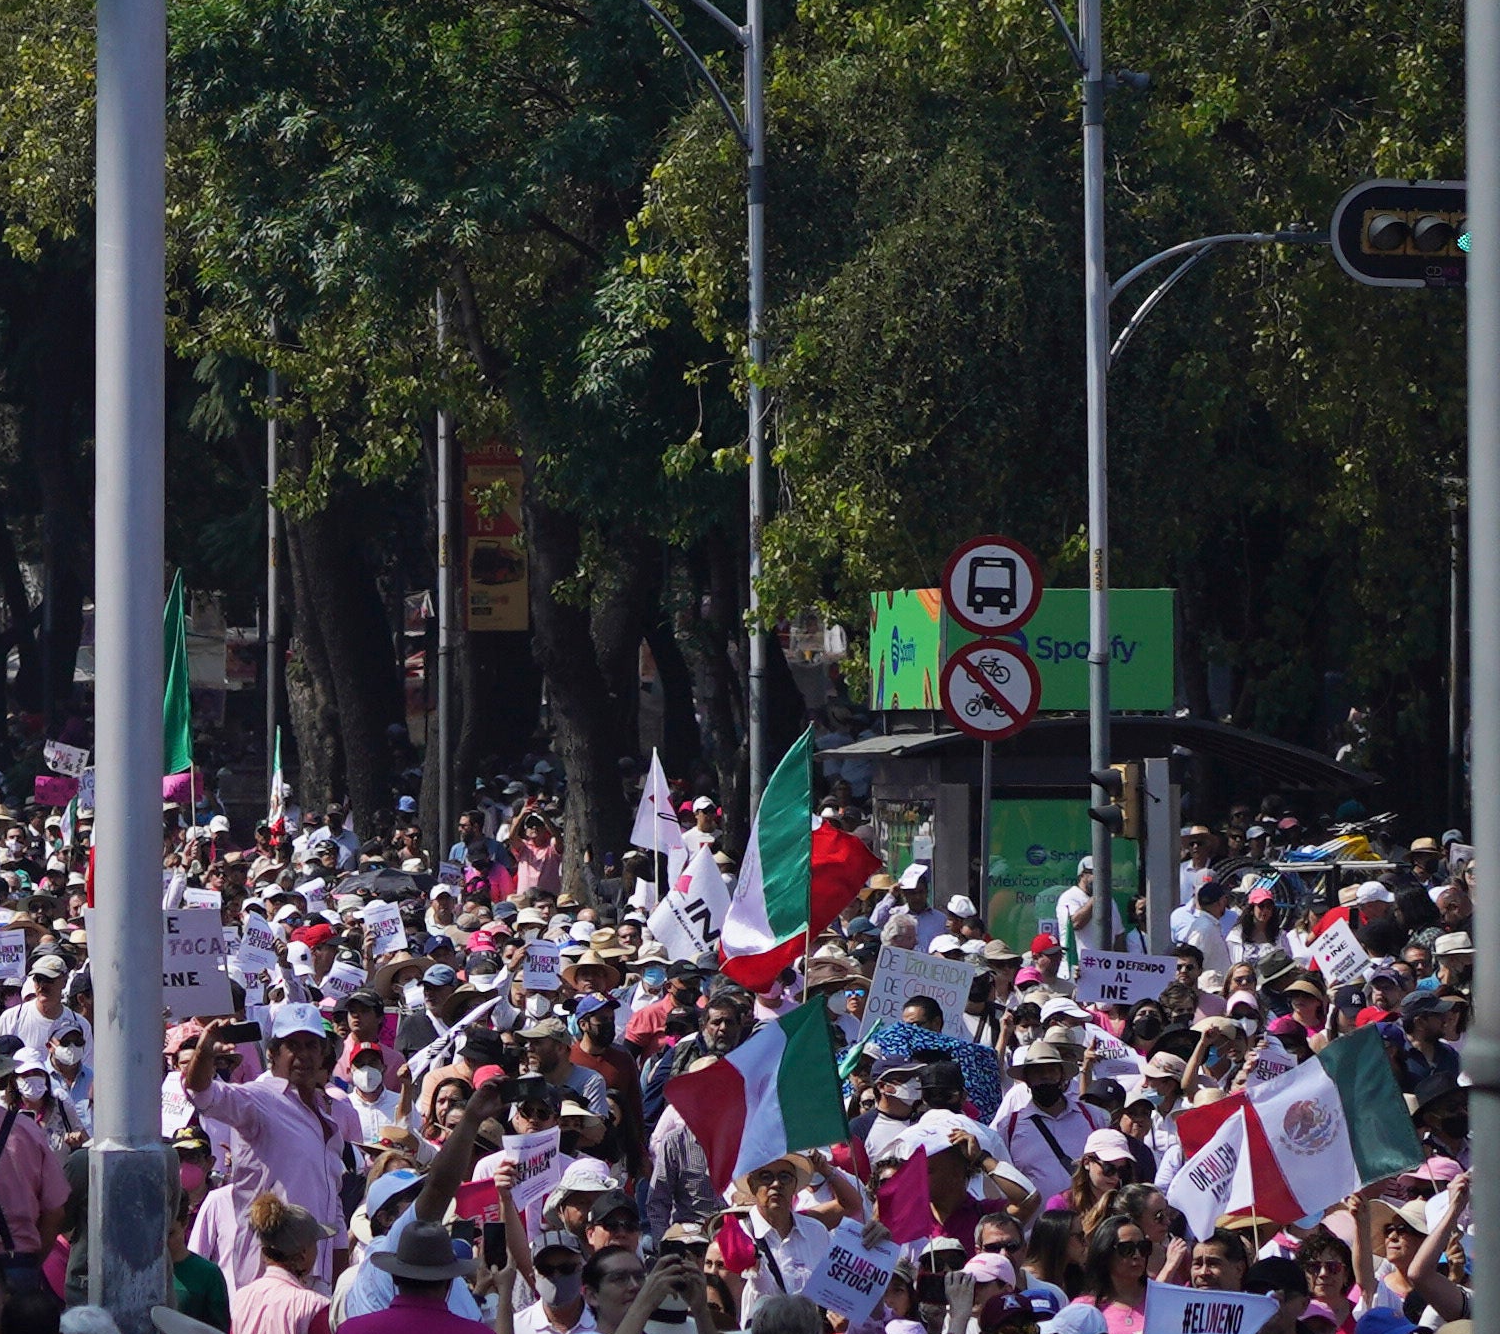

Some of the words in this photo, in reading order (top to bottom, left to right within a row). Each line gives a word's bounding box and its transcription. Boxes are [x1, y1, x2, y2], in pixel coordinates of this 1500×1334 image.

[1036, 635, 1137, 664] Spofy
[988, 873, 1040, 887] México
[1043, 877, 1058, 887] es
[684, 897, 722, 953] IN
[1330, 939, 1349, 958] INE
[529, 963, 556, 974] SETOCA
[879, 948, 900, 972] DE
[1083, 956, 1112, 970] #YO
[1116, 958, 1166, 975] DEFIENDO
[1115, 971, 1132, 984] AL
[883, 976, 899, 996] DE
[903, 977, 957, 1007] CENTRO
[1100, 984, 1129, 1002] INE
[882, 999, 900, 1018] DE
[514, 1147, 557, 1174] ELINENO
[828, 1245, 889, 1286] #ELINENO
[827, 1262, 875, 1296] SETOCA
